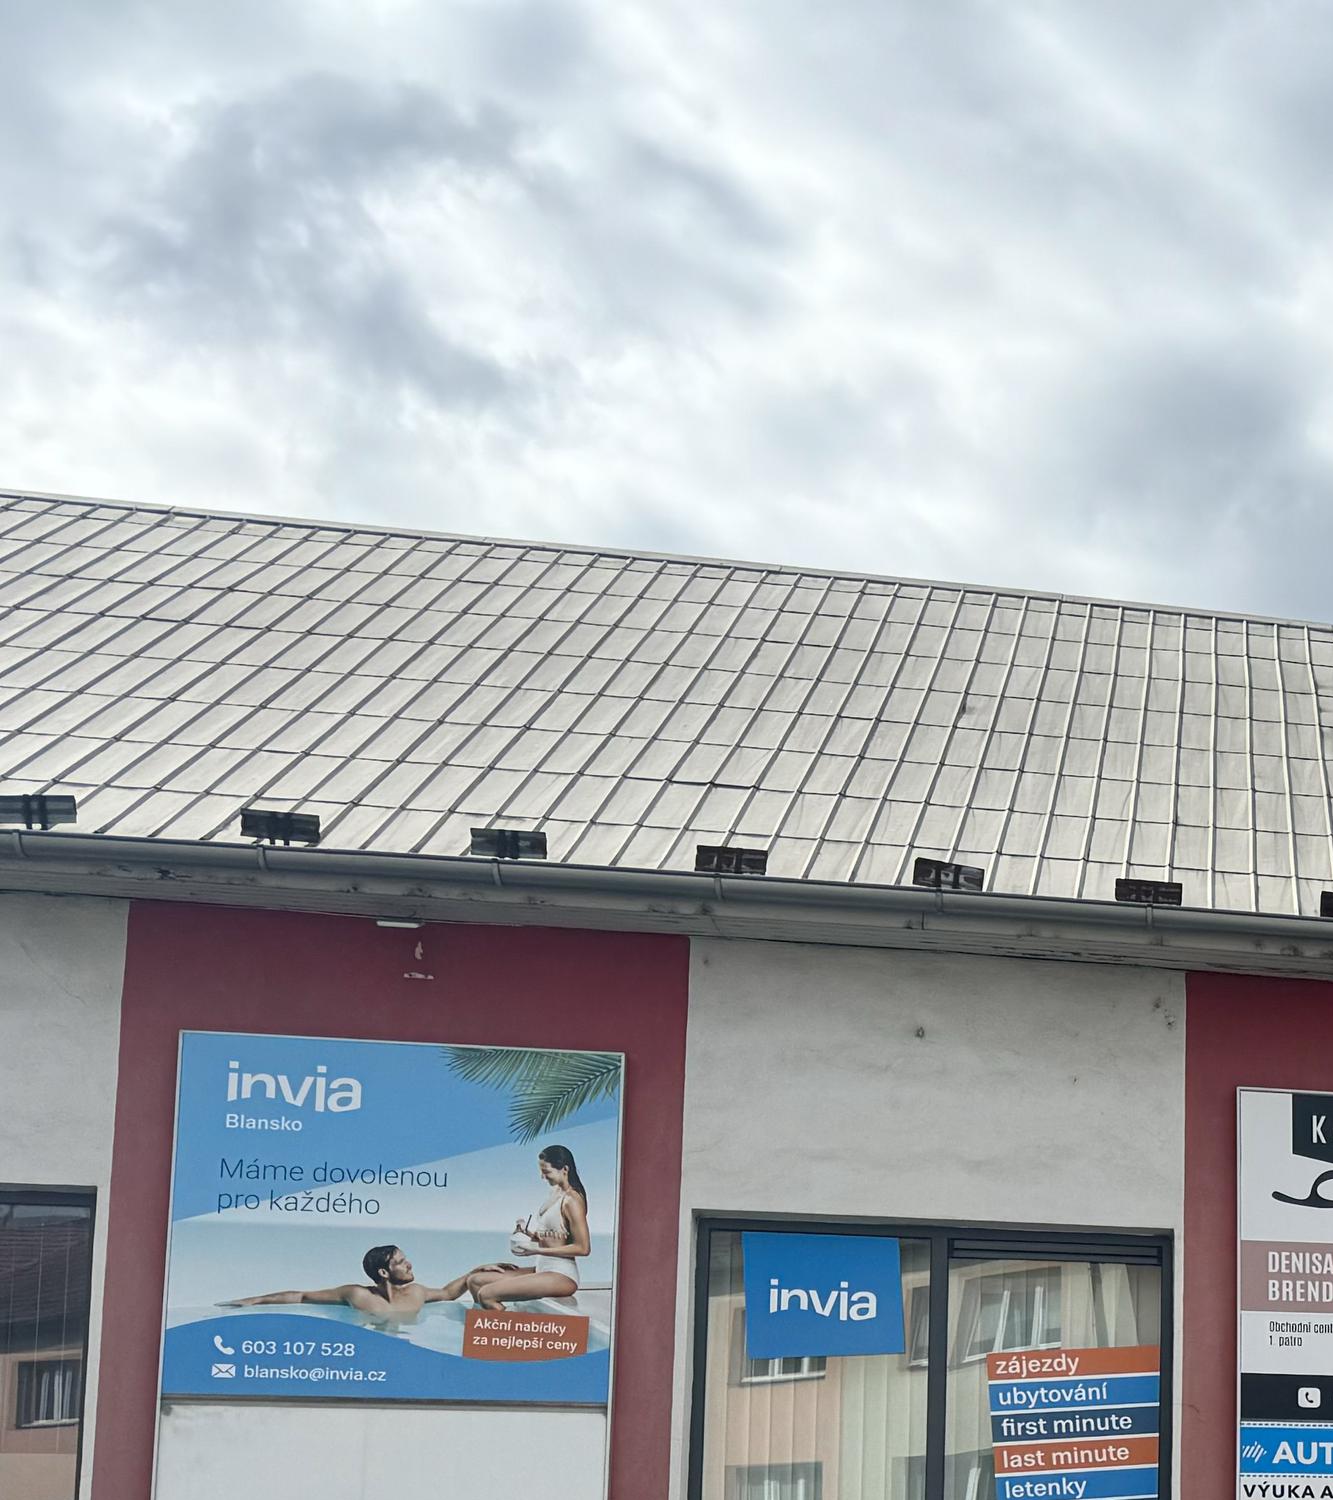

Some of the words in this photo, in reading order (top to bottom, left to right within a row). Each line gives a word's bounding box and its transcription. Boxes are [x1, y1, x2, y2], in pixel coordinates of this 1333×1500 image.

[227, 1061, 362, 1112] invia
[225, 1114, 303, 1131] Blansko
[220, 1158, 304, 1182] Máme
[313, 1162, 448, 1188] dovolenou
[217, 1192, 260, 1214] pro
[270, 1190, 380, 1215] každého
[769, 1279, 877, 1321] invia
[474, 1318, 512, 1331] Akční
[515, 1321, 566, 1337] nabídky
[1269, 1320, 1311, 1333] Obchodní
[242, 1340, 277, 1354] 603
[283, 1341, 316, 1355] 107
[321, 1343, 355, 1357] 528
[473, 1336, 488, 1345] za
[492, 1336, 543, 1350] nejlepší
[546, 1341, 578, 1353] ceny
[1279, 1336, 1303, 1347] patro
[244, 1365, 387, 1382] blansko@invia.cz
[995, 1353, 1080, 1377] zájezdy
[998, 1382, 1108, 1408] ubytování
[1000, 1416, 1047, 1437] first
[1052, 1411, 1133, 1433] minute
[1002, 1447, 1044, 1468] last
[1051, 1443, 1130, 1466] minute
[1243, 1481, 1315, 1499] VÝUKA
[1320, 1486, 1333, 1499] A
